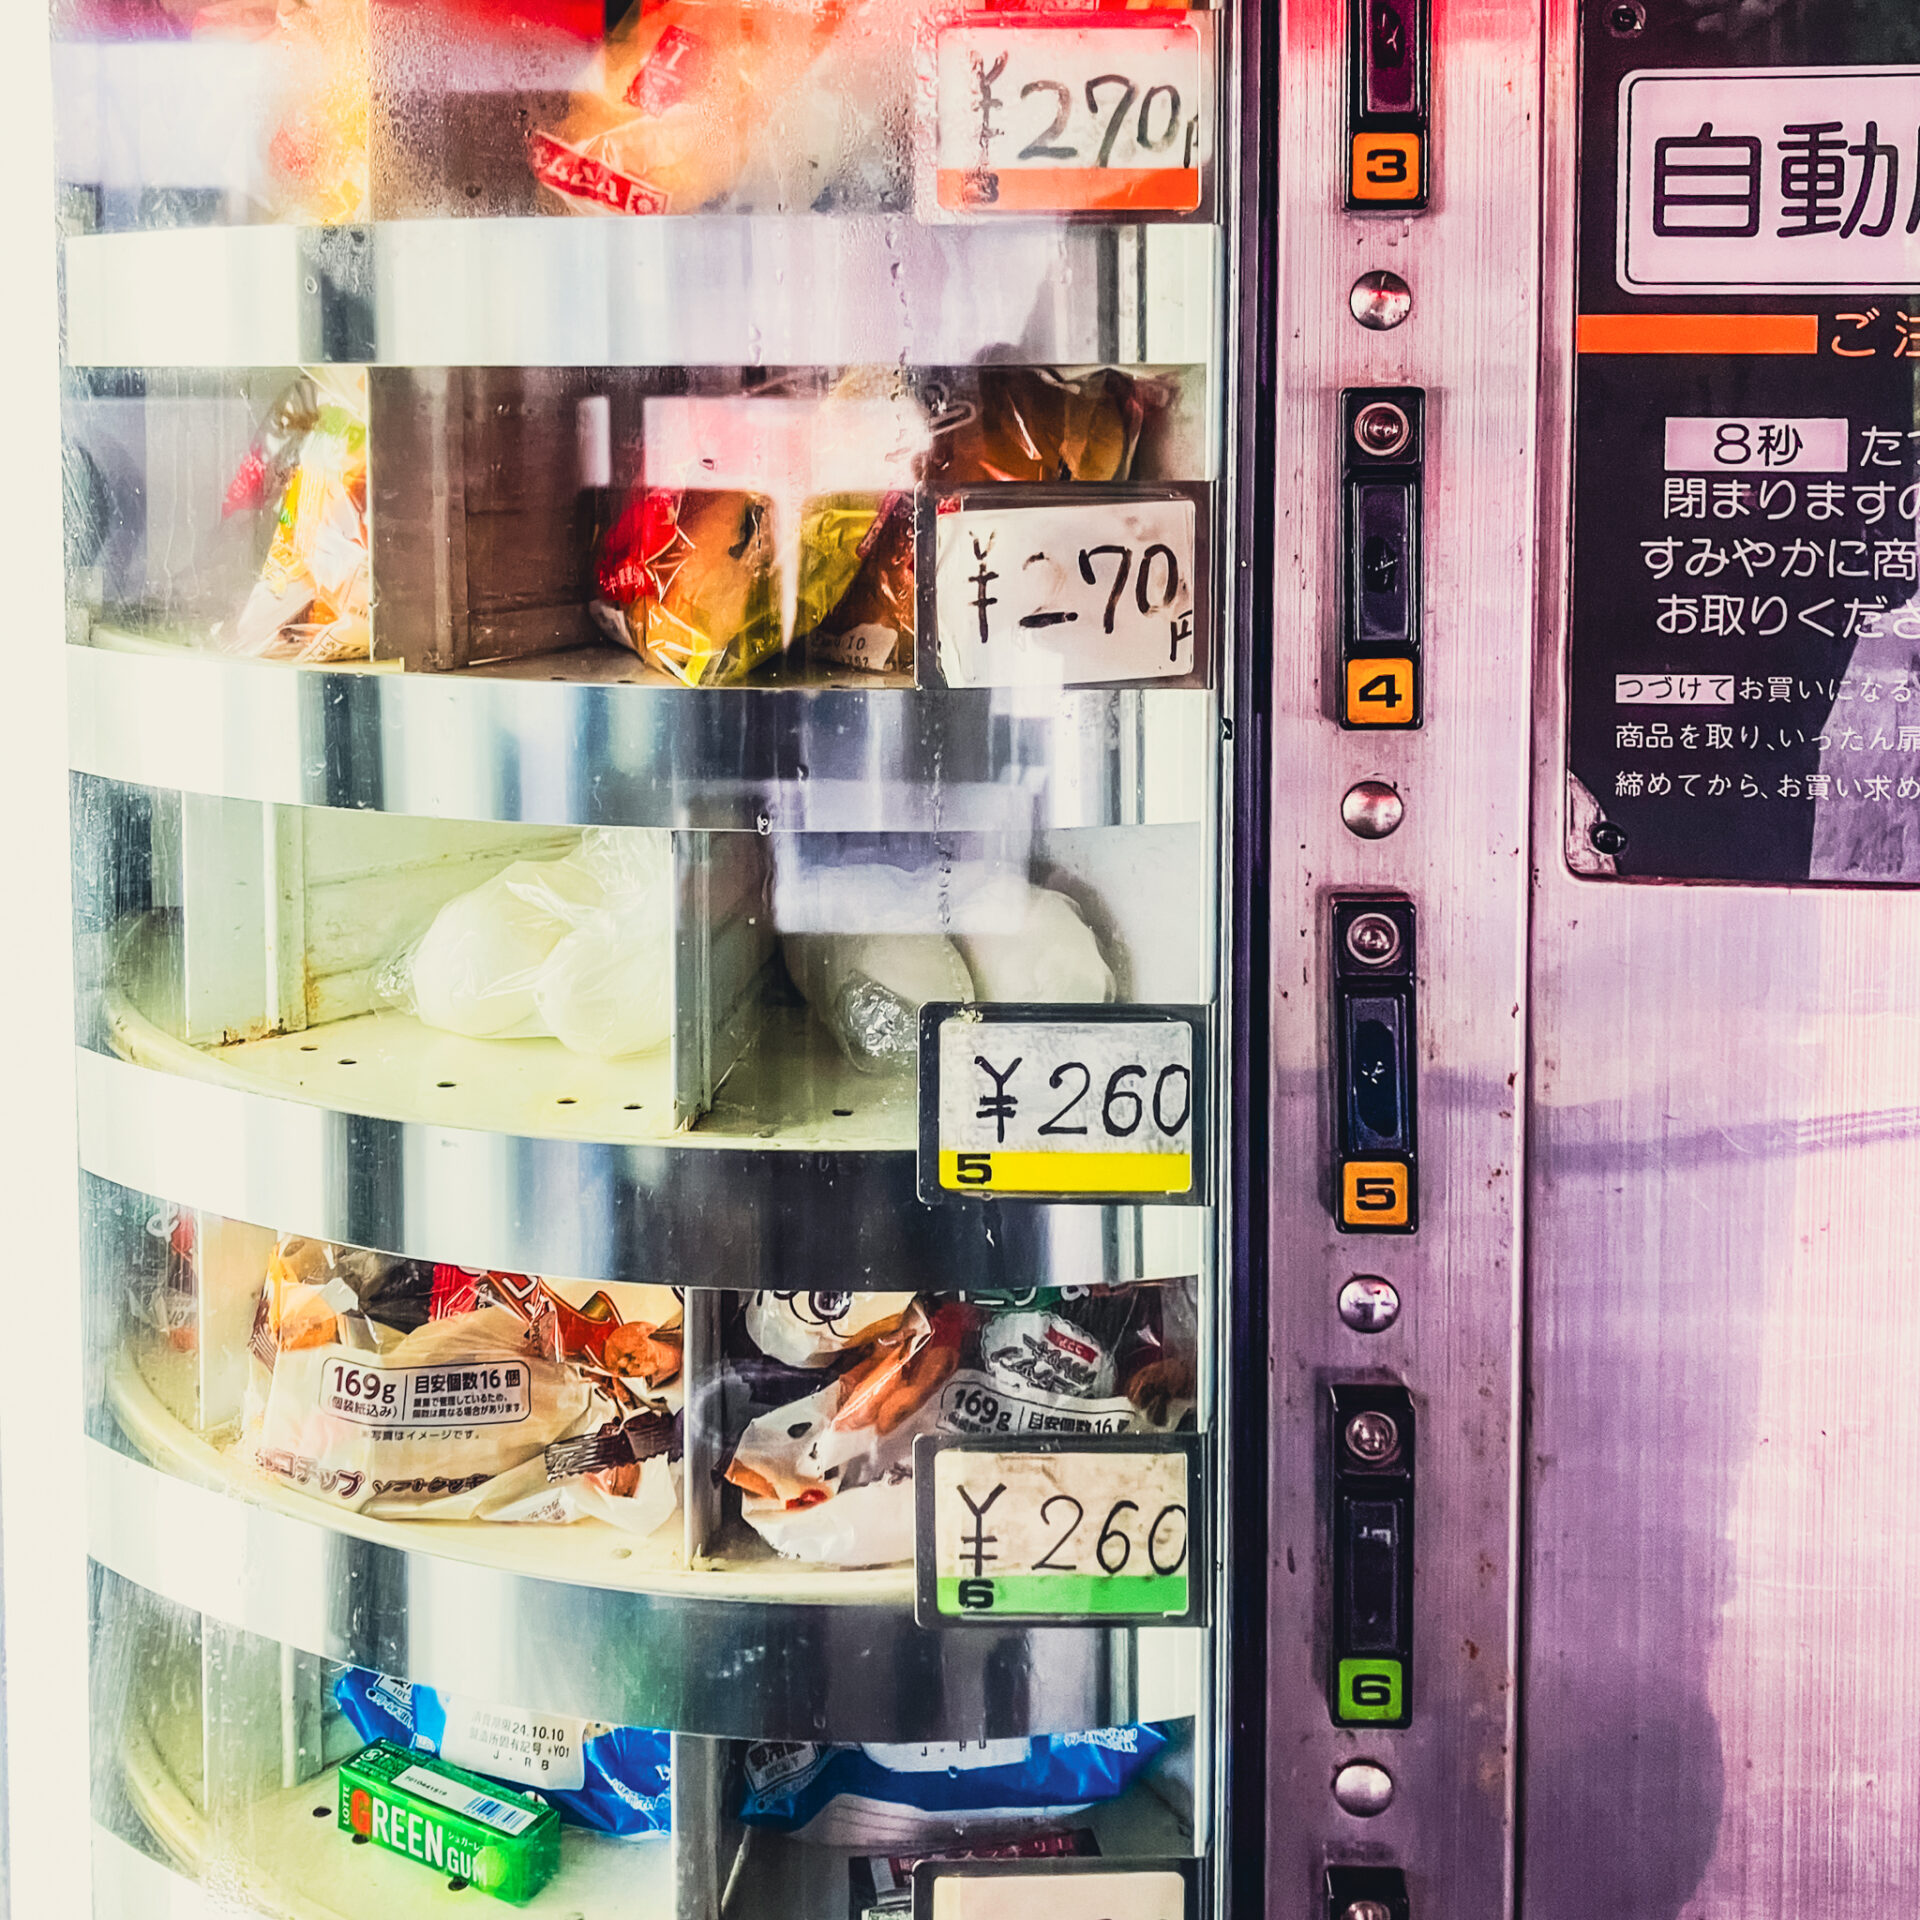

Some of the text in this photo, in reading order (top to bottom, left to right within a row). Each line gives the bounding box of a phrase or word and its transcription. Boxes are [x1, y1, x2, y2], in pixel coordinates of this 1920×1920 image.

[1366, 148, 1407, 184] 3
[1652, 119, 1920, 239] 自動
[1713, 422, 1804, 467] 8秒
[1639, 535, 1920, 581] すみやかに商
[1655, 593, 1920, 640] お取りくださ
[1358, 673, 1403, 709] 4
[1617, 675, 1912, 704] つづけて お買いになる
[973, 1054, 1192, 1145] ¥260
[955, 1152, 994, 1186] 5
[1355, 1177, 1397, 1211] 5
[333, 1364, 398, 1405] 169g
[955, 1389, 1013, 1432] 169g
[956, 1482, 1186, 1577] ¥260
[957, 1578, 995, 1609] 6
[1351, 1673, 1392, 1707] 6
[351, 1788, 443, 1868] GREEN
